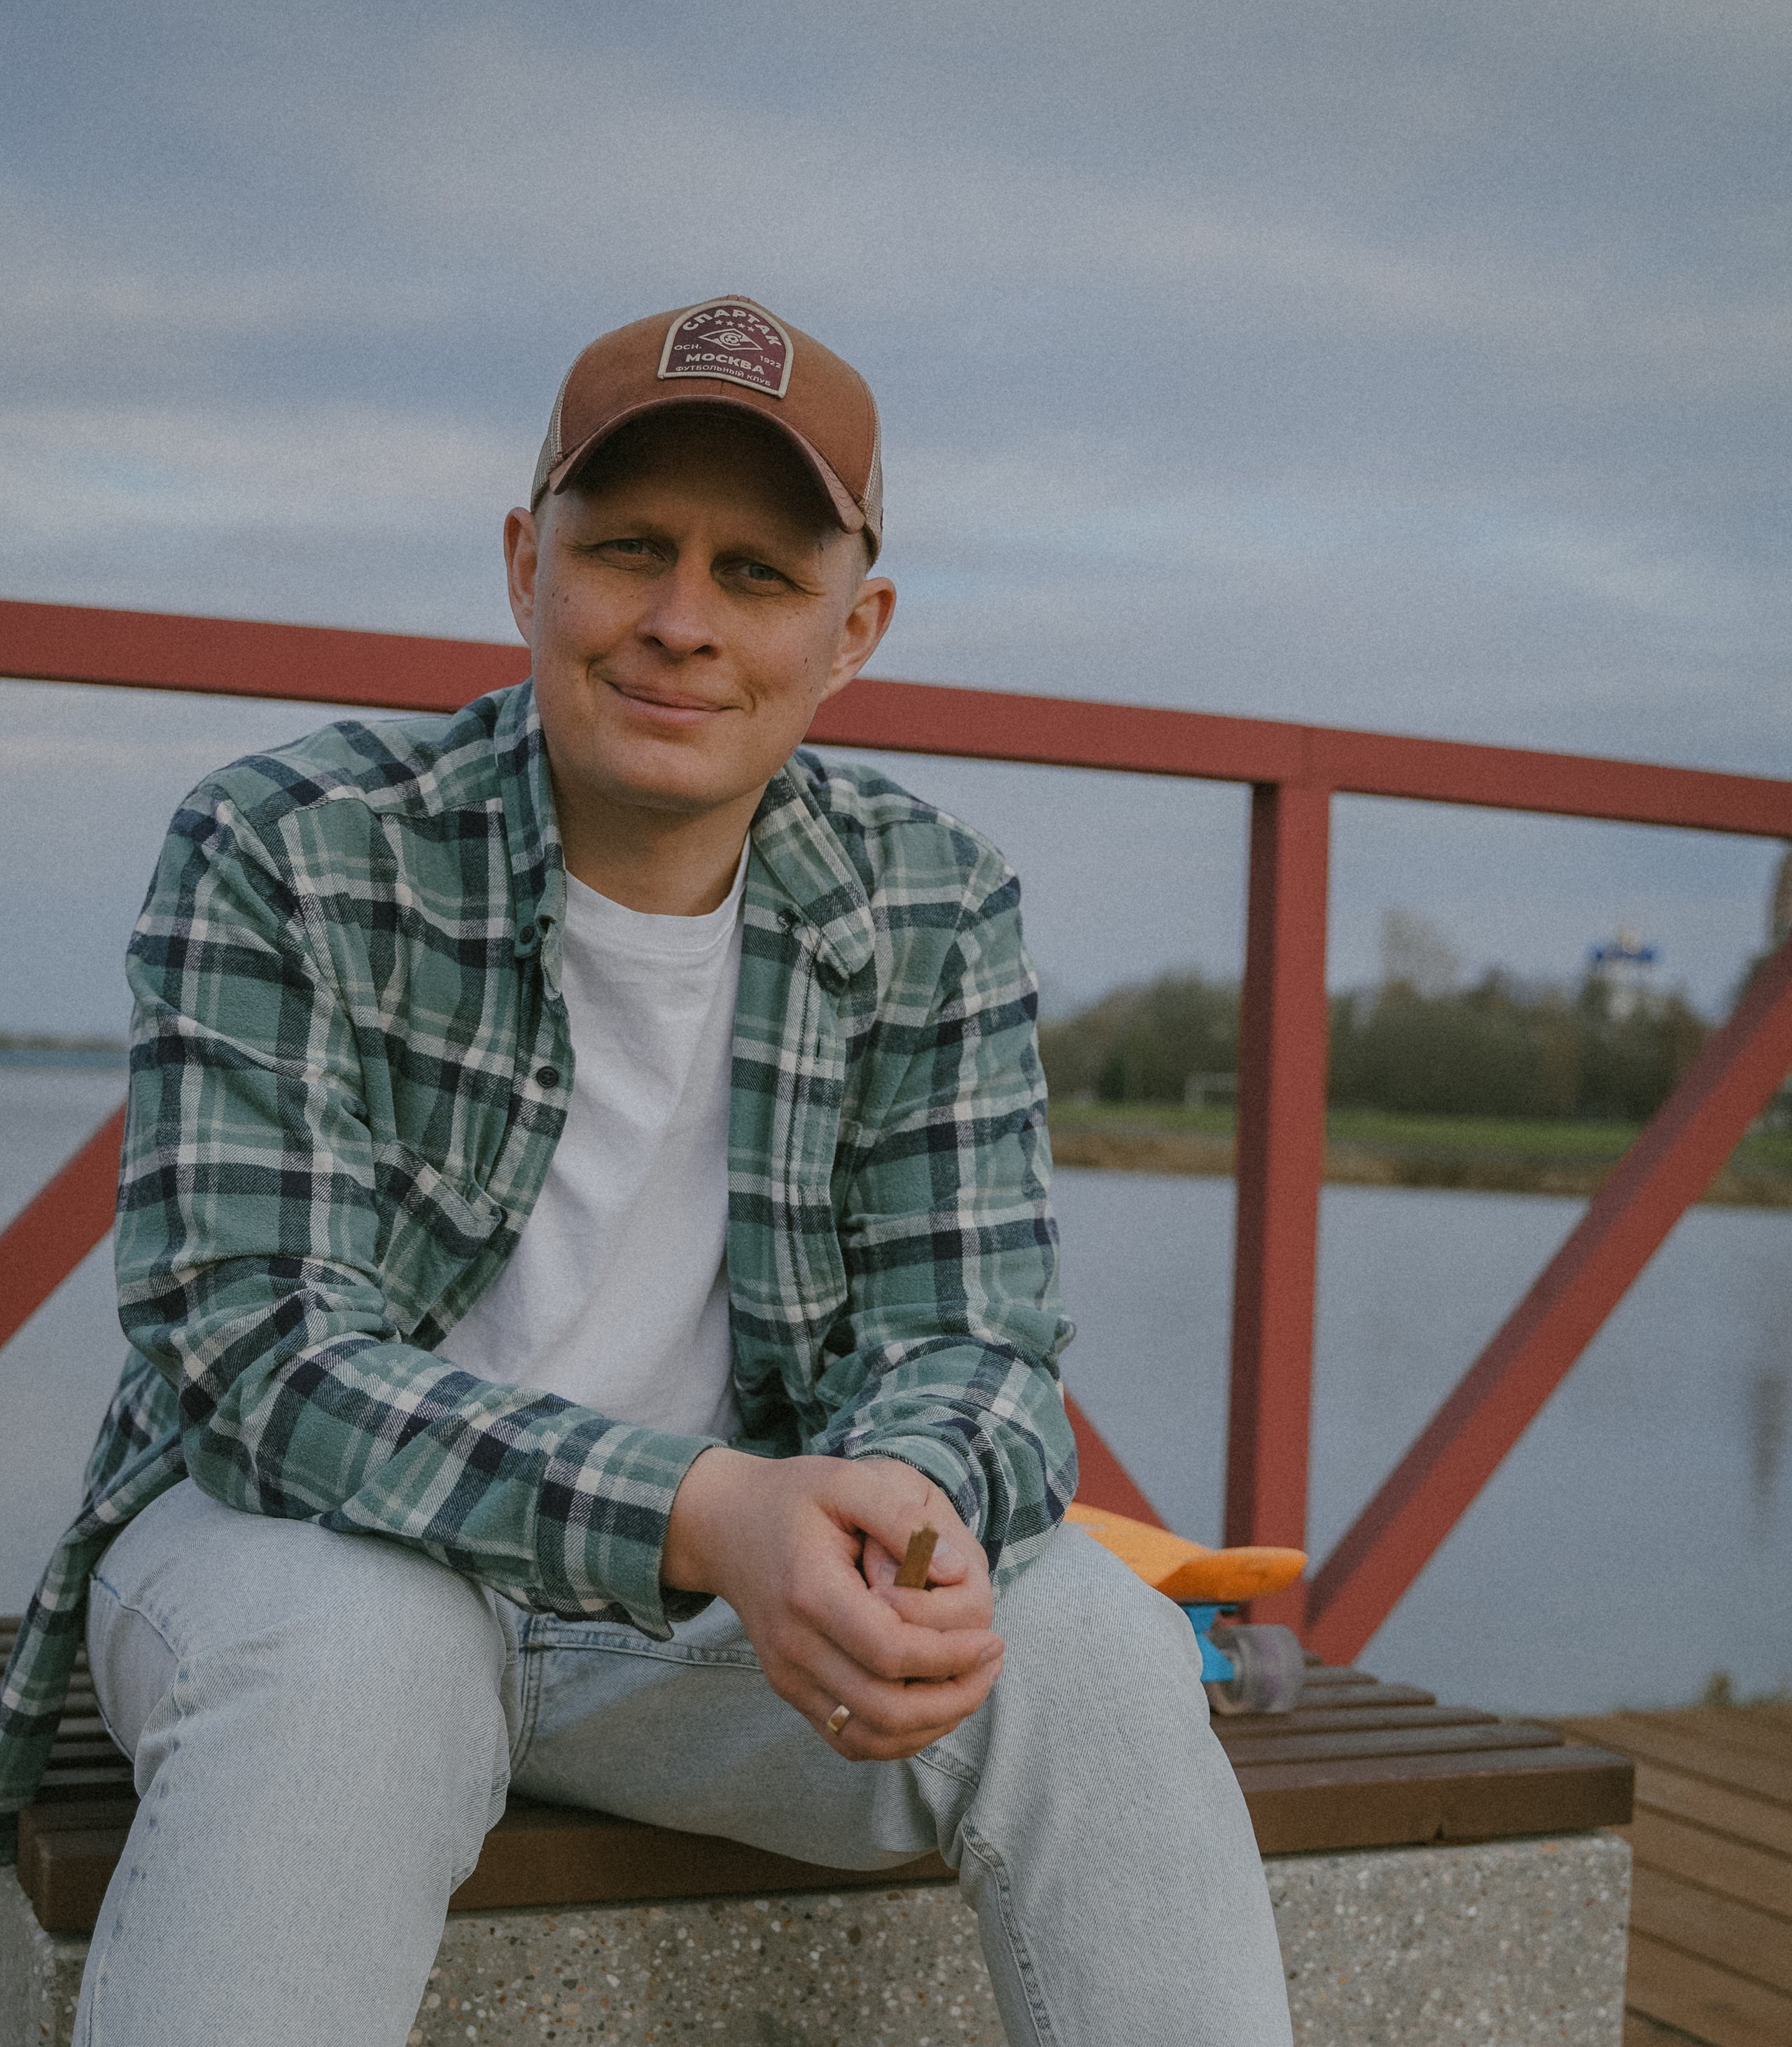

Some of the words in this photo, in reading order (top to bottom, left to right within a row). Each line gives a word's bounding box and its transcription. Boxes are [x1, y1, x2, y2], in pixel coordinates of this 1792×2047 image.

[682, 309, 783, 347] СПАРТАК
[685, 353, 765, 375] МОСКВА
[760, 355, 782, 369] 1922
[676, 364, 745, 378] ФУТБОЛЬНЫЙ
[746, 375, 771, 386] КЛУБ
